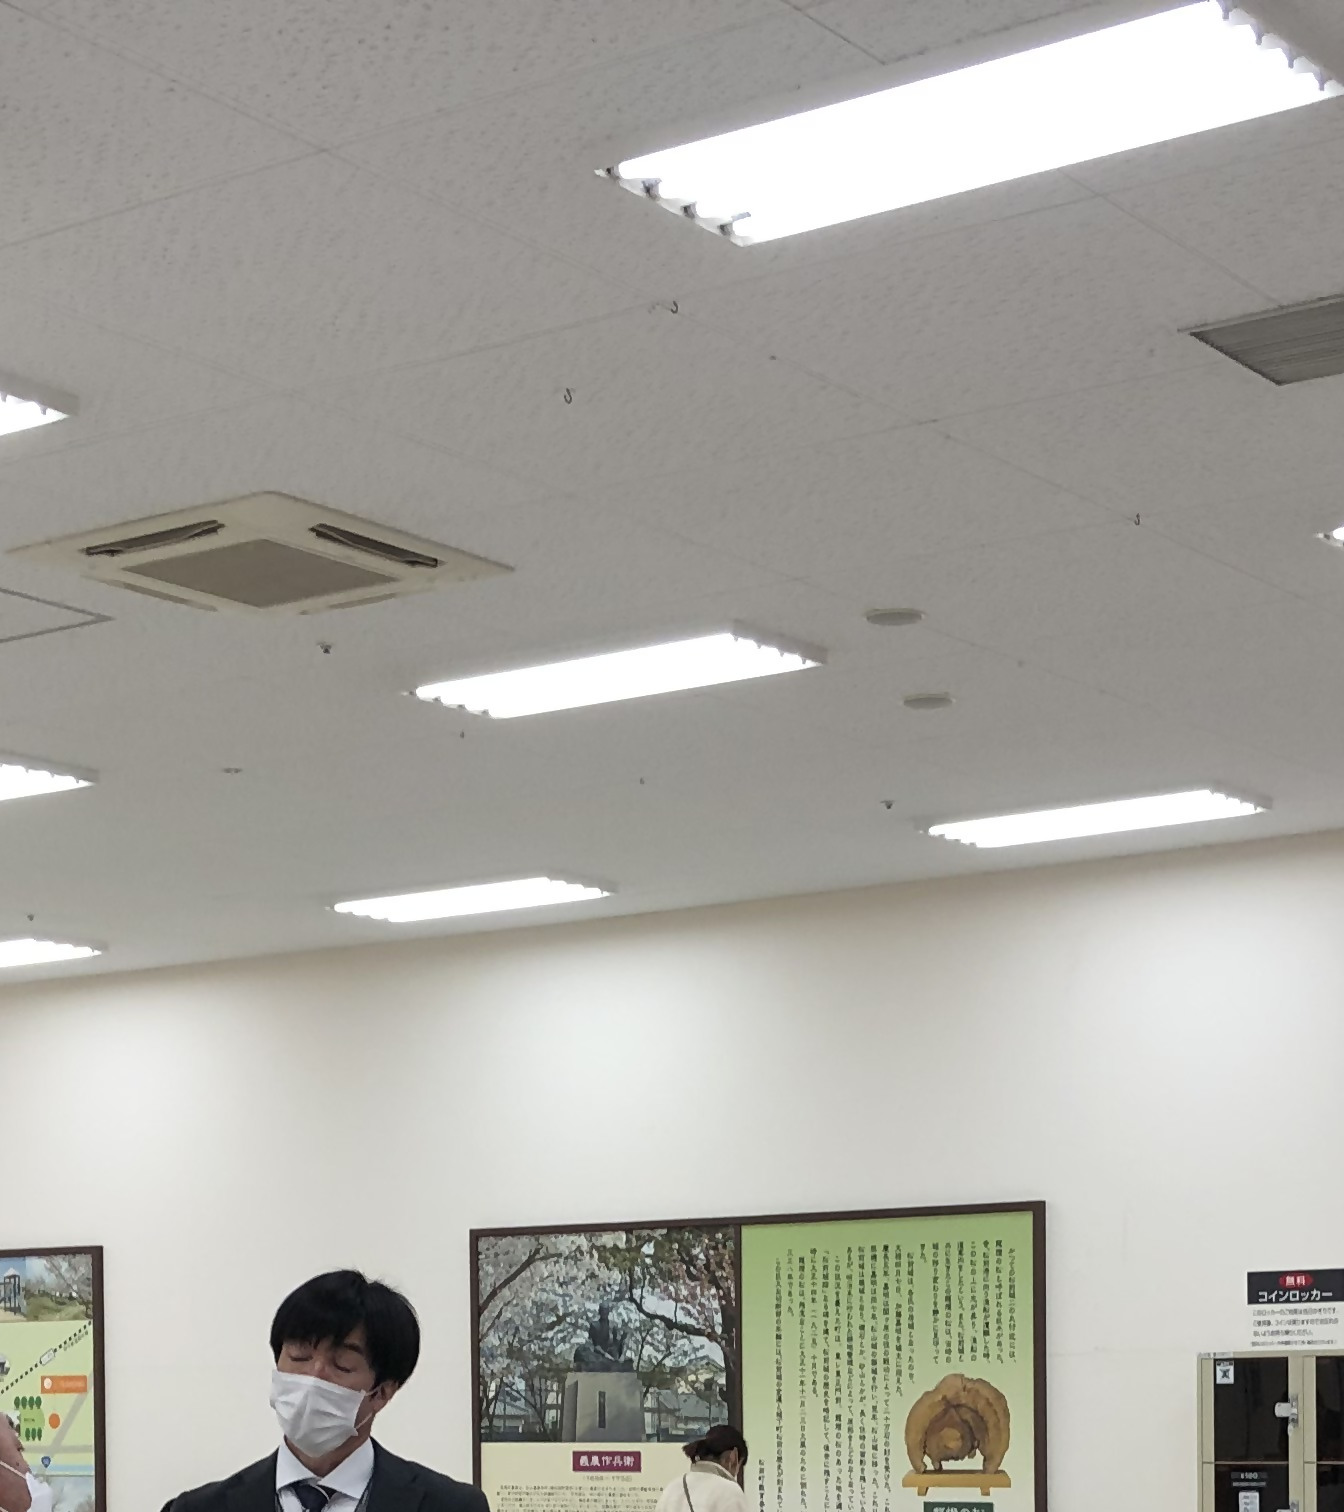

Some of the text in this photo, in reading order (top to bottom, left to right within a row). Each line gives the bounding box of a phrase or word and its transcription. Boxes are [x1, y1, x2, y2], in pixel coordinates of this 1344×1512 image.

[1285, 1275, 1305, 1286] 無料
[1258, 1289, 1333, 1302] コインロッカー
